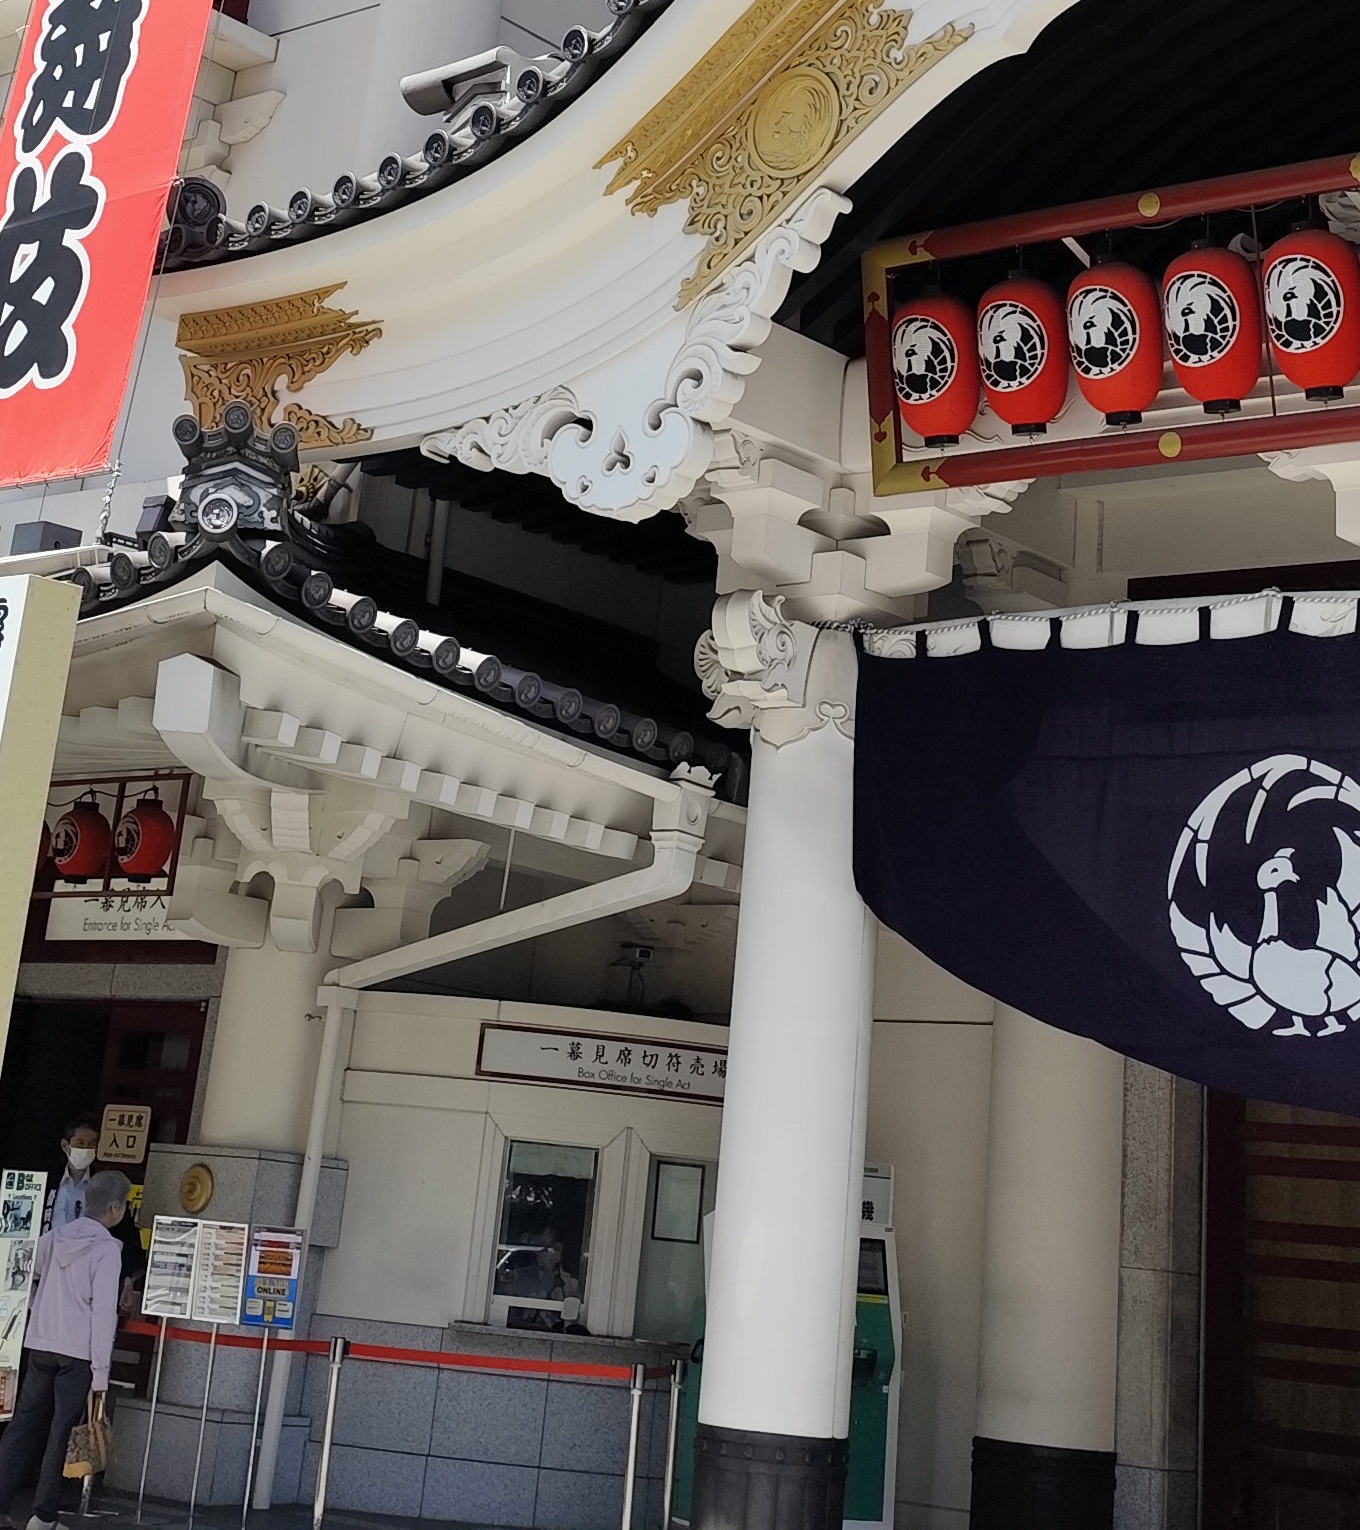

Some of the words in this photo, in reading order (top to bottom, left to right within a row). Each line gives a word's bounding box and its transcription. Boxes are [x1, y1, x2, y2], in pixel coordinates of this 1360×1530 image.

[83, 917, 118, 932] Entrance
[120, 916, 132, 931] for
[133, 917, 160, 935] Single
[540, 1041, 727, 1079] 一幕見席切符売場
[578, 1067, 596, 1079] Box
[598, 1069, 628, 1084] Office
[630, 1074, 643, 1086] for
[645, 1075, 674, 1090] Single
[676, 1081, 691, 1090] Act
[108, 1132, 137, 1148] 入口
[256, 1286, 287, 1297] ONLINE
